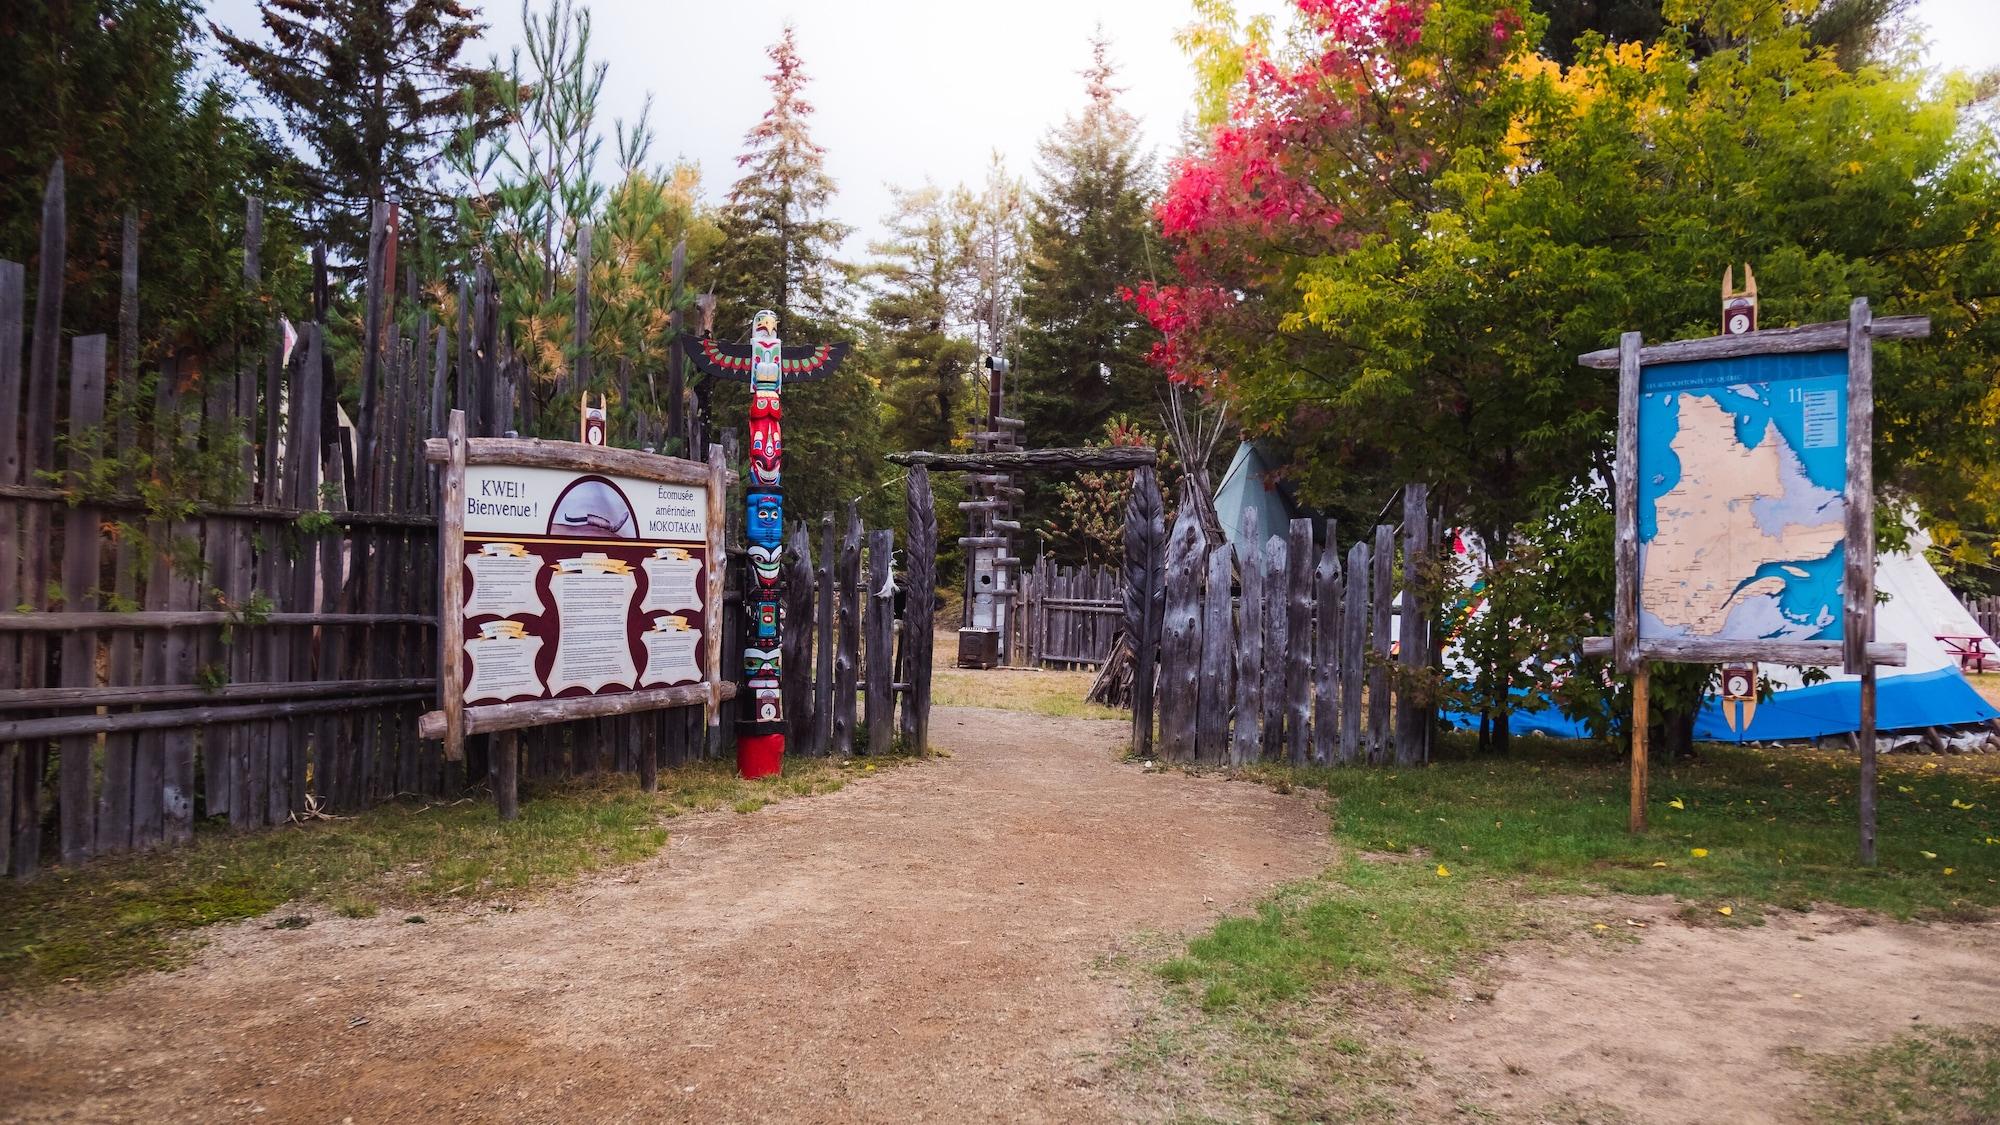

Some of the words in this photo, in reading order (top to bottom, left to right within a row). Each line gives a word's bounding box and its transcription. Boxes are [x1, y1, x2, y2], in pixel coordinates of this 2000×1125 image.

[1736, 319, 1743, 330] 3
[1789, 387, 1802, 403] 11
[593, 431, 597, 441] 1
[481, 480, 518, 498] KWEI
[658, 485, 694, 501] Écomusée
[467, 498, 531, 517] Bienvenue
[655, 504, 696, 517] amérindien
[649, 520, 702, 533] MOKOTAKAN
[1735, 680, 1742, 691] 2
[765, 708, 772, 716] 4
